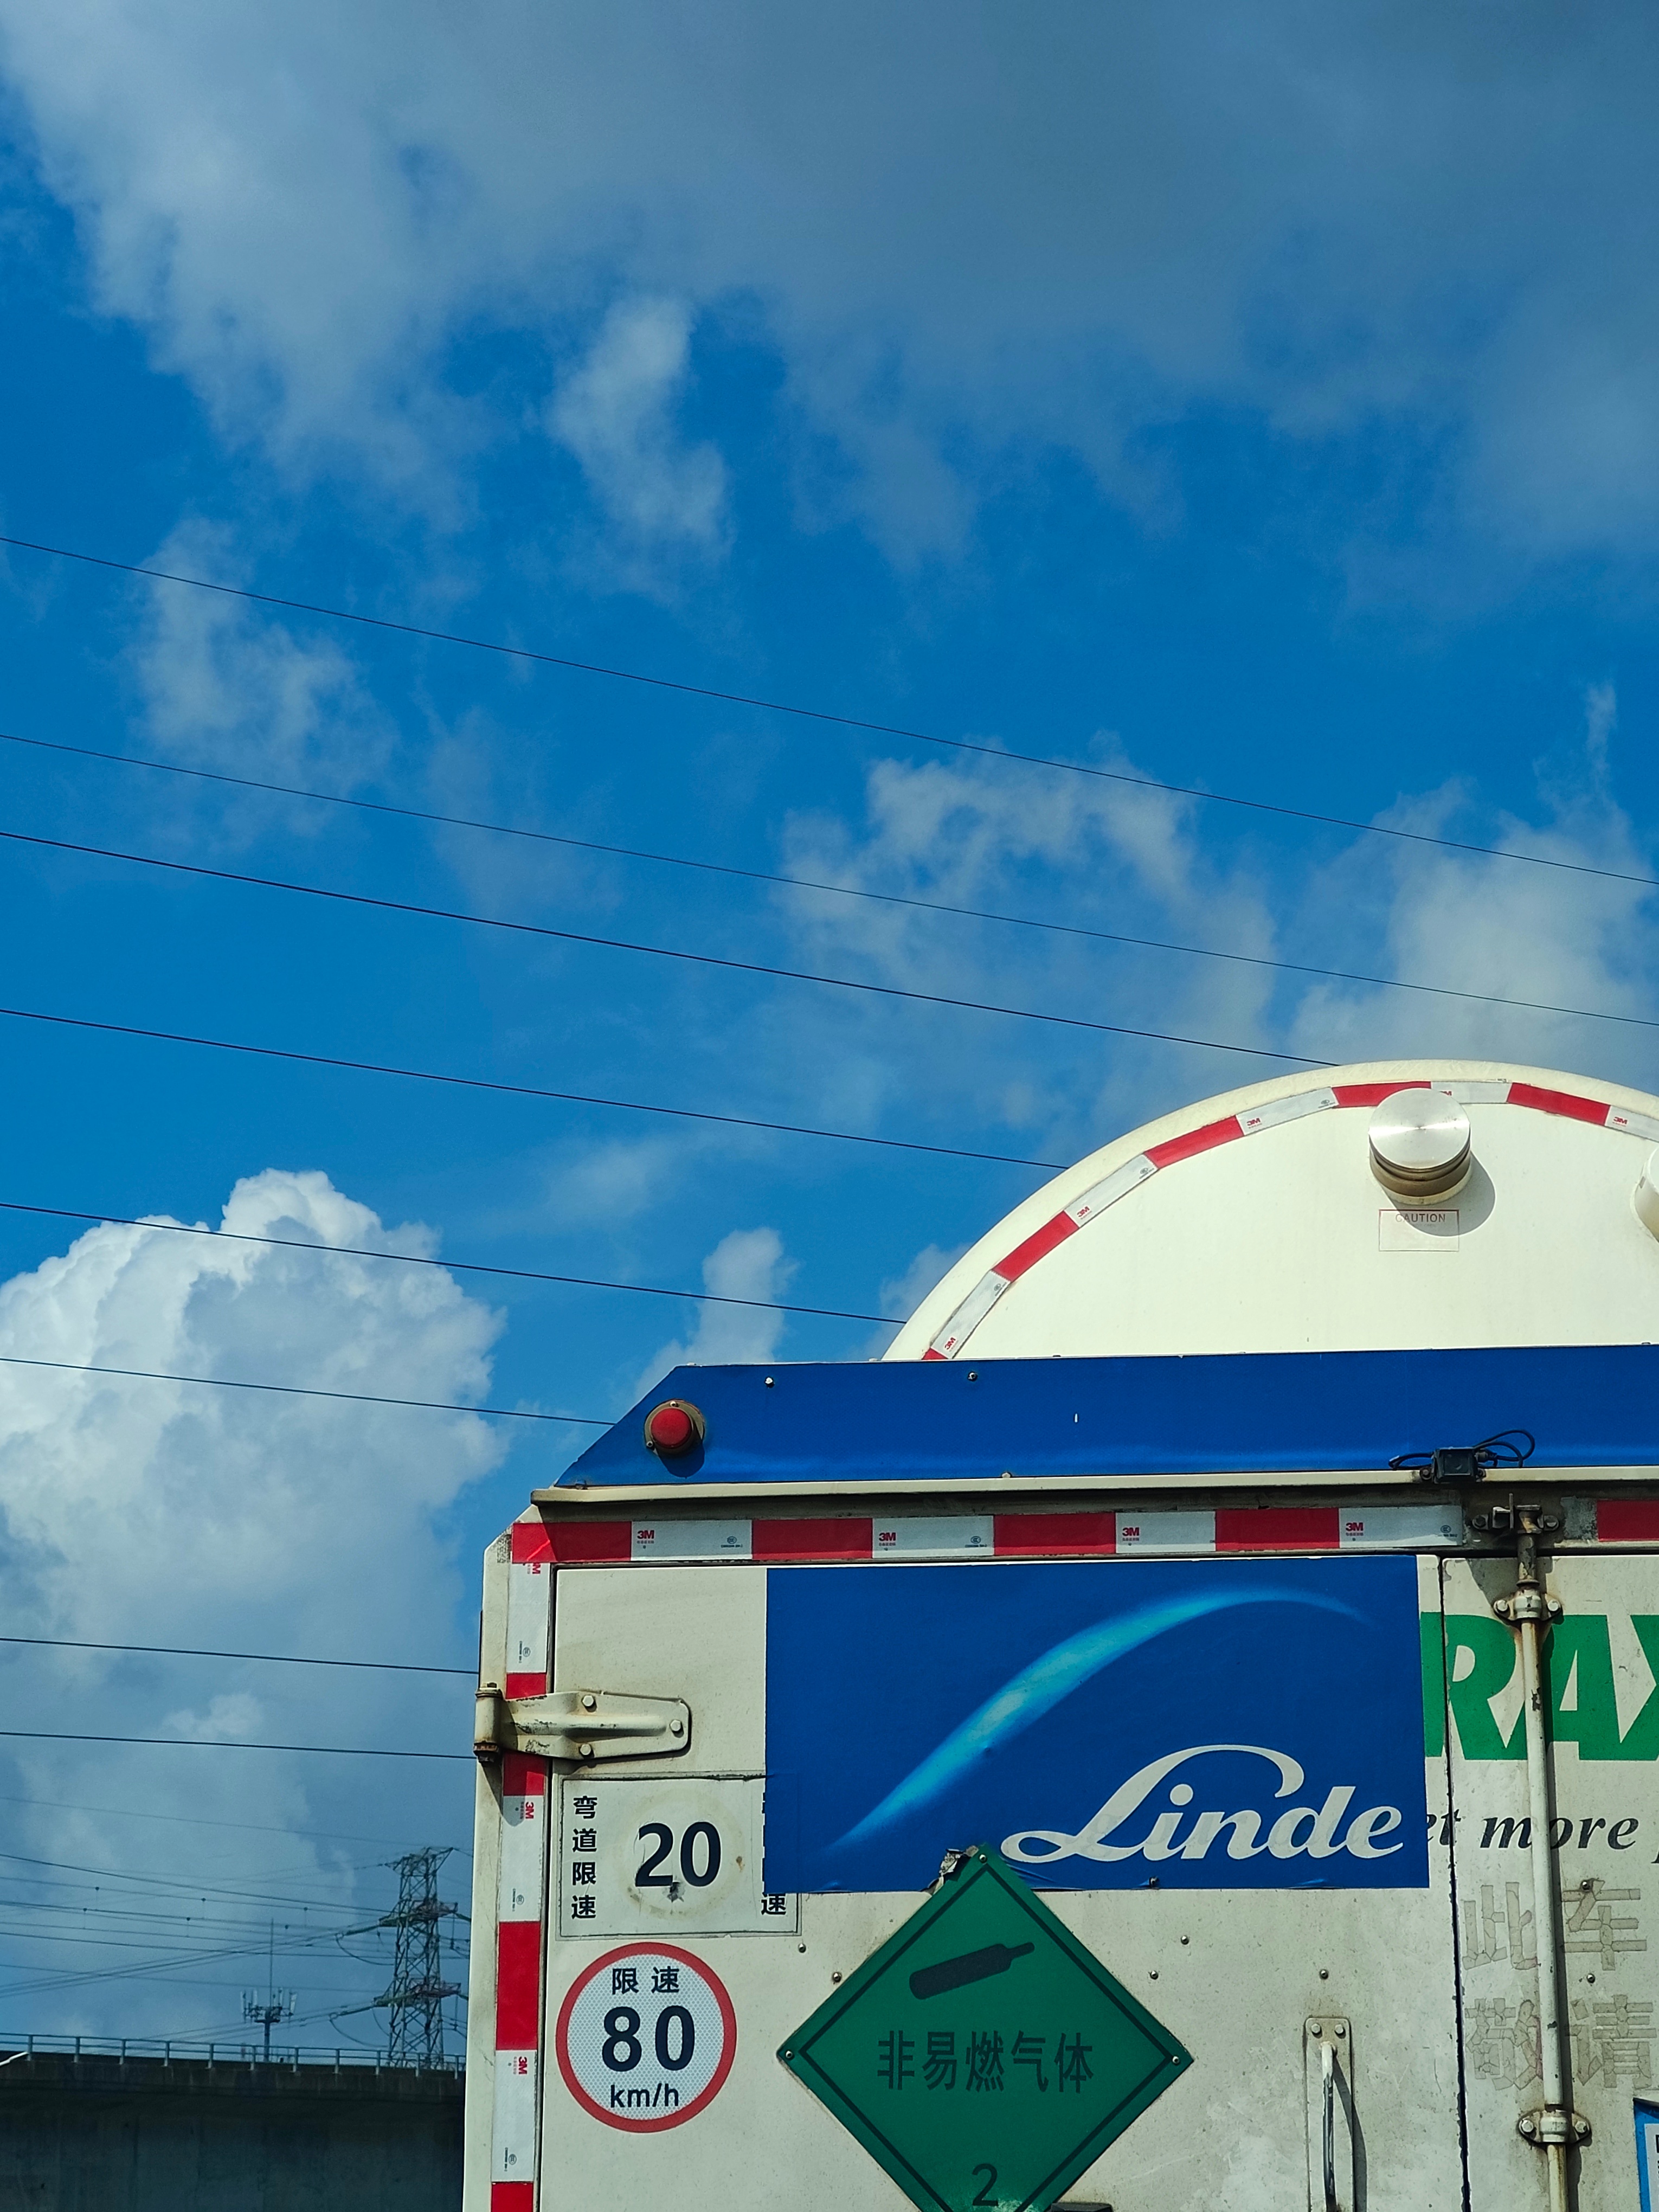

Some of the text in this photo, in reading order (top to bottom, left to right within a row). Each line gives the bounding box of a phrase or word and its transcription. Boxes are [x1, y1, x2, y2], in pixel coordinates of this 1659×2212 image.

[1247, 1117, 1261, 1126] 3M
[1613, 1116, 1628, 1124] 3M
[1077, 1206, 1090, 1218] 3M
[1396, 1213, 1446, 1223] CAUTION
[944, 1337, 956, 1350] 3M
[637, 1530, 655, 1539] 3M
[1122, 1527, 1140, 1536] 3M
[1346, 1522, 1364, 1531] 3M
[879, 1532, 896, 1541] 3M
[525, 1801, 535, 1819] 3M
[1001, 1744, 1404, 1863] Linde
[1480, 1817, 1639, 1850] more
[571, 1795, 597, 1920] 弯道限速
[635, 1821, 722, 1887] 20
[611, 1965, 680, 1995] 限速
[602, 2005, 695, 2072] 80
[518, 2056, 528, 2074] 3M
[877, 2030, 1094, 2093] 非易燃气体
[610, 2082, 679, 2108] km/h
[972, 2163, 999, 2207] 2
